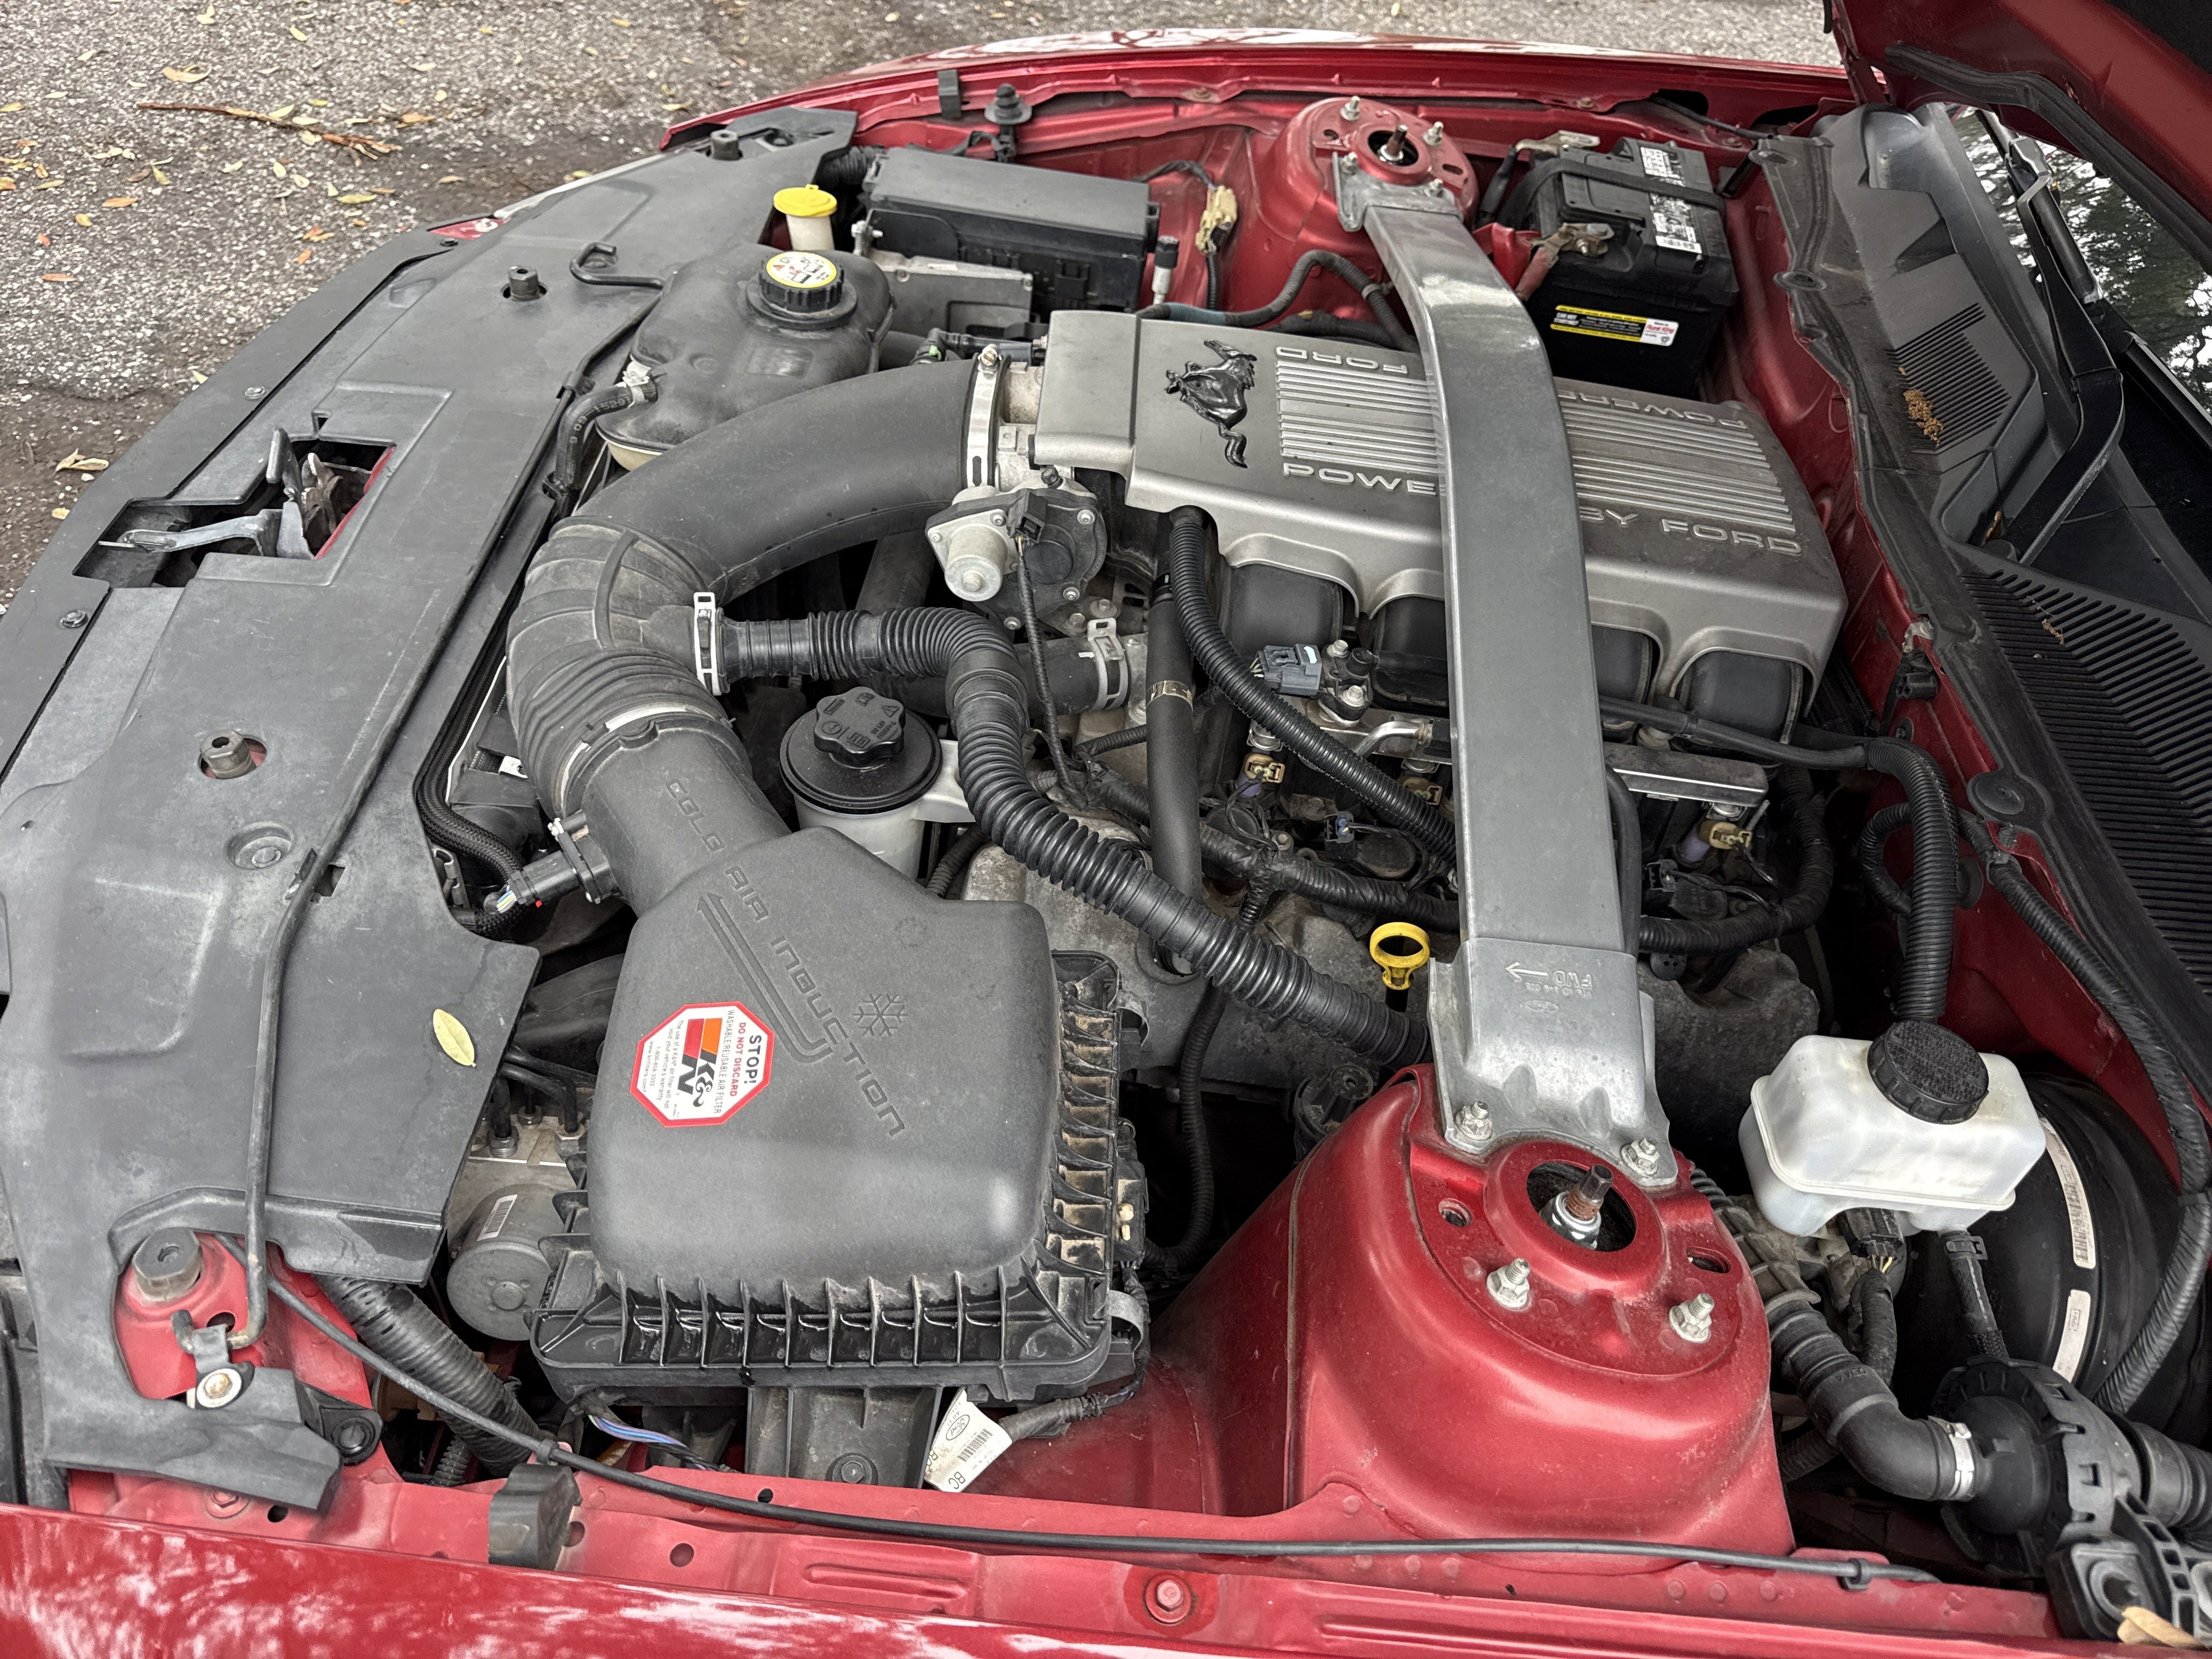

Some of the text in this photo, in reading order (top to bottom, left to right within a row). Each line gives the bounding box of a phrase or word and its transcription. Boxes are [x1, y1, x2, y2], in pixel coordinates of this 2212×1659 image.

[1276, 346, 1408, 374] FORD
[1557, 390, 1747, 428] POWERE
[1283, 462, 1437, 496] POWE
[1661, 518, 1802, 557] FORD
[665, 778, 907, 1138] COLD AIR INDUCTION
[1554, 970, 1593, 990] FWD
[650, 1046, 661, 1086] 1-800-858-3333
[713, 1009, 735, 1113] WASHABLE/REUSABLE AIR FILTER
[730, 1022, 746, 1096] DO NOT DISCARD
[744, 1035, 762, 1084] STOP!
[656, 1077, 665, 1101] warranty
[948, 1471, 966, 1489] BC
